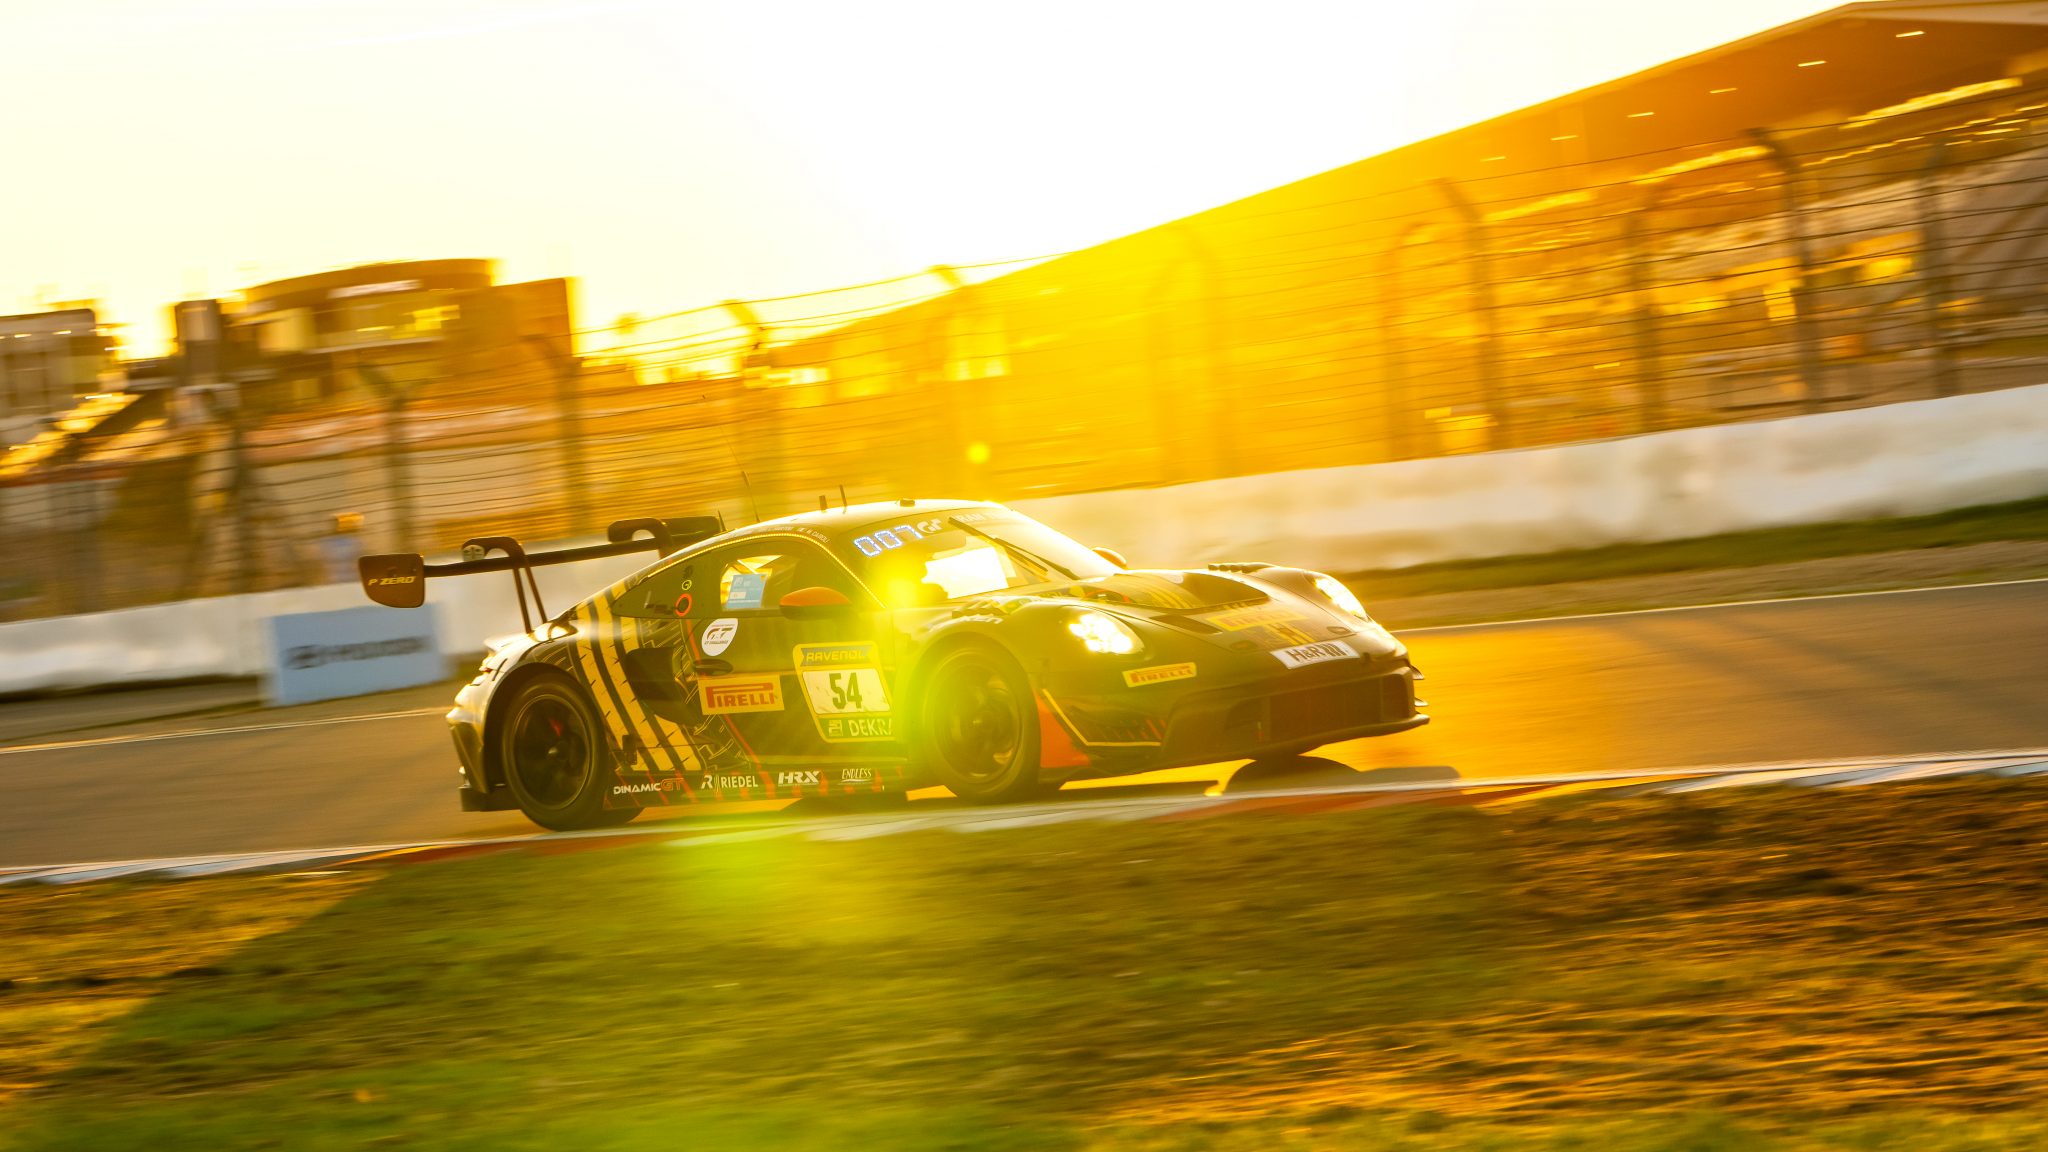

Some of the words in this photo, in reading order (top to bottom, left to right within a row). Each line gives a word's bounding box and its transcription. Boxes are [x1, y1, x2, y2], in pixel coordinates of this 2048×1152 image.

[367, 578, 378, 587] P
[379, 576, 416, 586] ZERO
[806, 650, 866, 662] RAVENOL
[1285, 647, 1326, 662] H&R
[1130, 665, 1193, 684] PIRELLI
[705, 682, 775, 709] PIRELLI
[829, 672, 863, 709] 54
[778, 770, 820, 784] HRX
[841, 768, 872, 780] ENDLESS
[721, 775, 759, 788] RIEDEL
